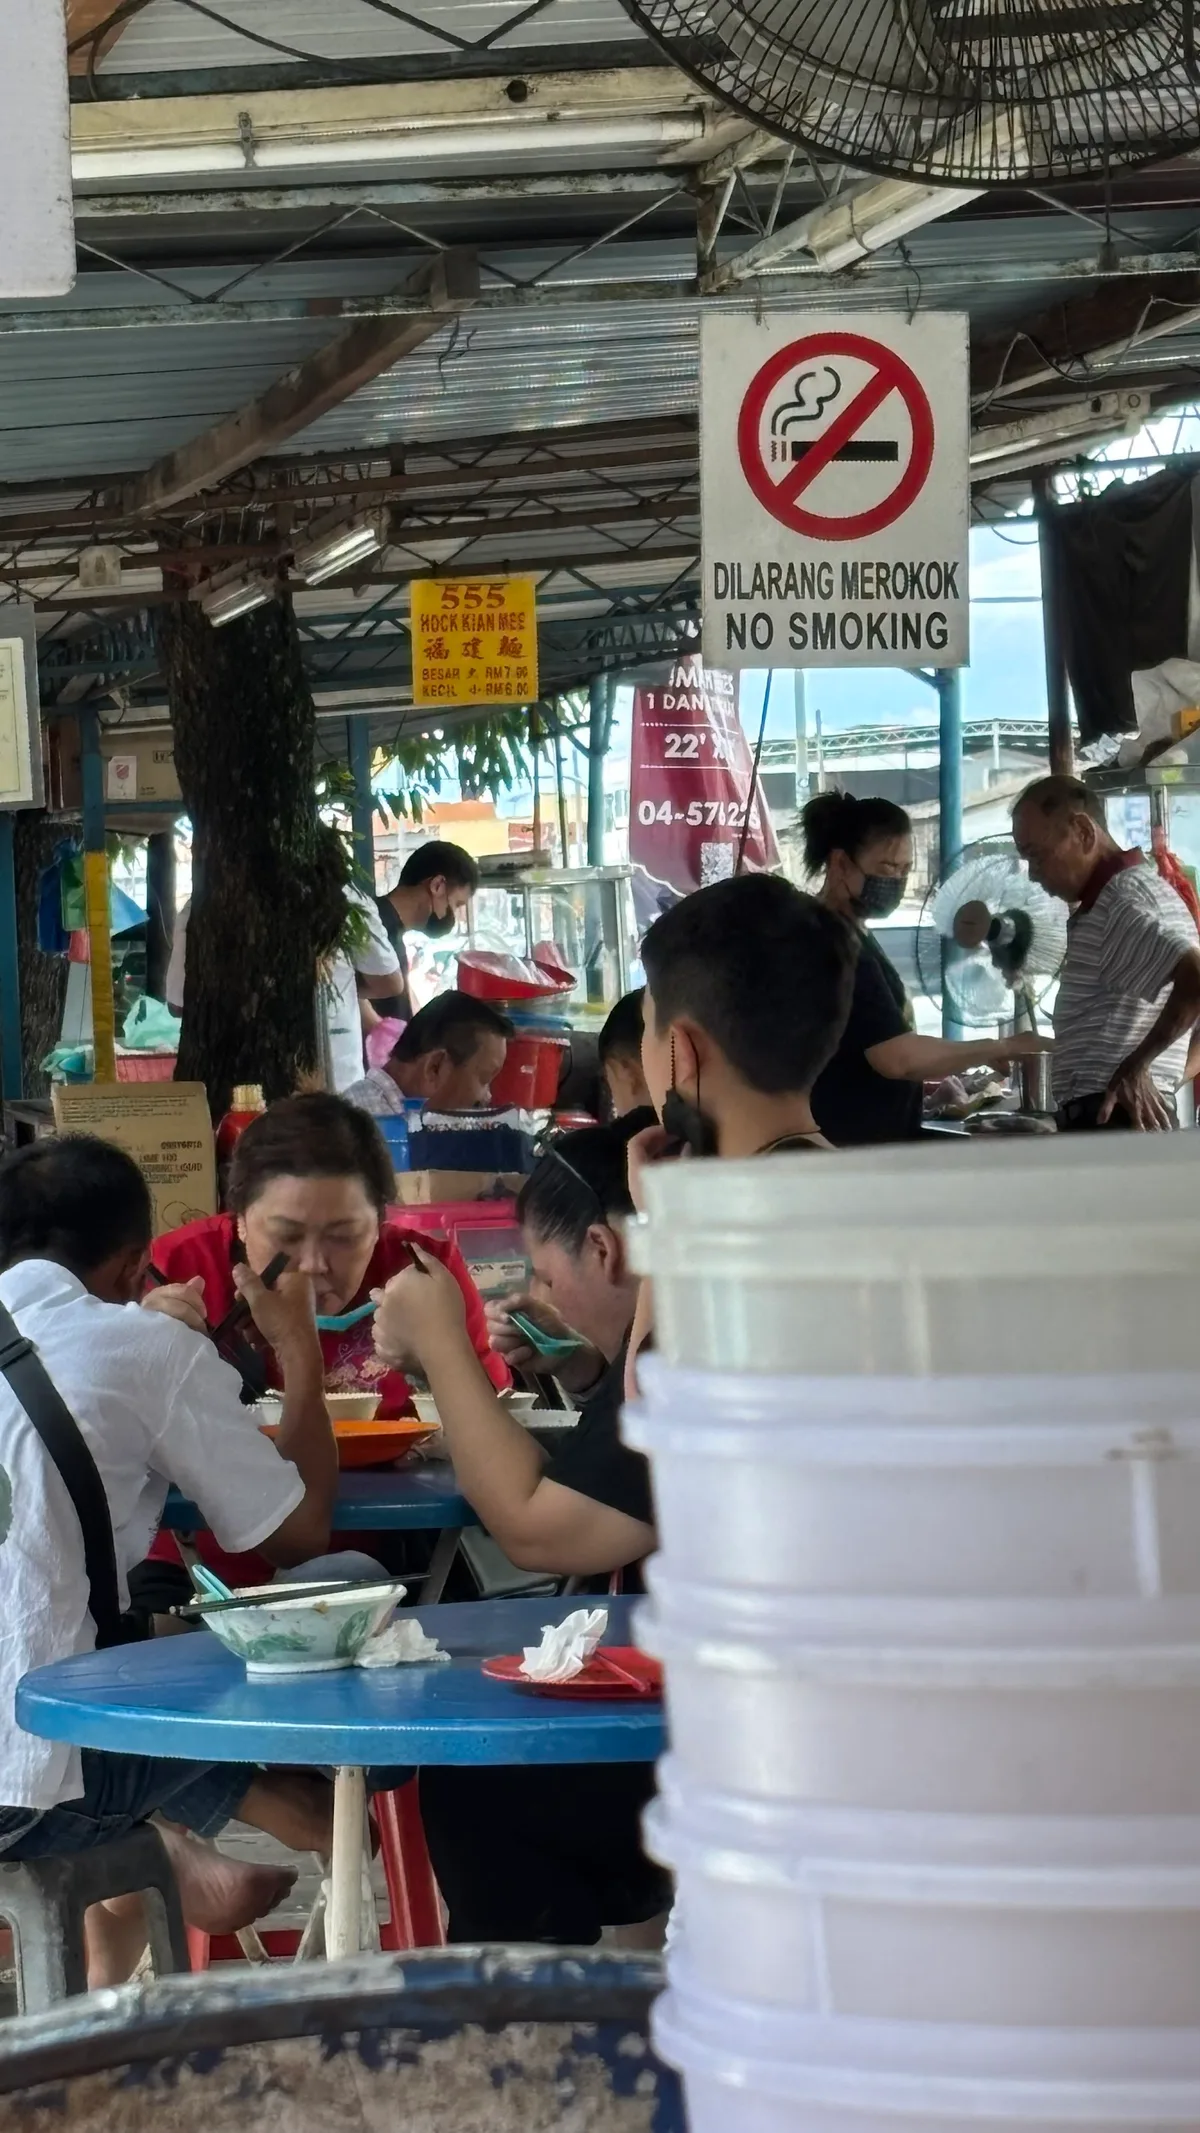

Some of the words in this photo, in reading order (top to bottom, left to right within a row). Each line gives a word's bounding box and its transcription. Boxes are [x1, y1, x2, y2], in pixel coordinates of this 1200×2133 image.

[714, 561, 834, 600] DILARANG
[841, 561, 960, 600] MEROKOK
[441, 584, 506, 610] 555
[462, 612, 495, 632] KIAN
[498, 612, 525, 632] MEE
[726, 612, 774, 650] NO
[788, 612, 948, 650] SMOKING
[422, 668, 460, 681] BESAR
[422, 684, 458, 697] KECIL
